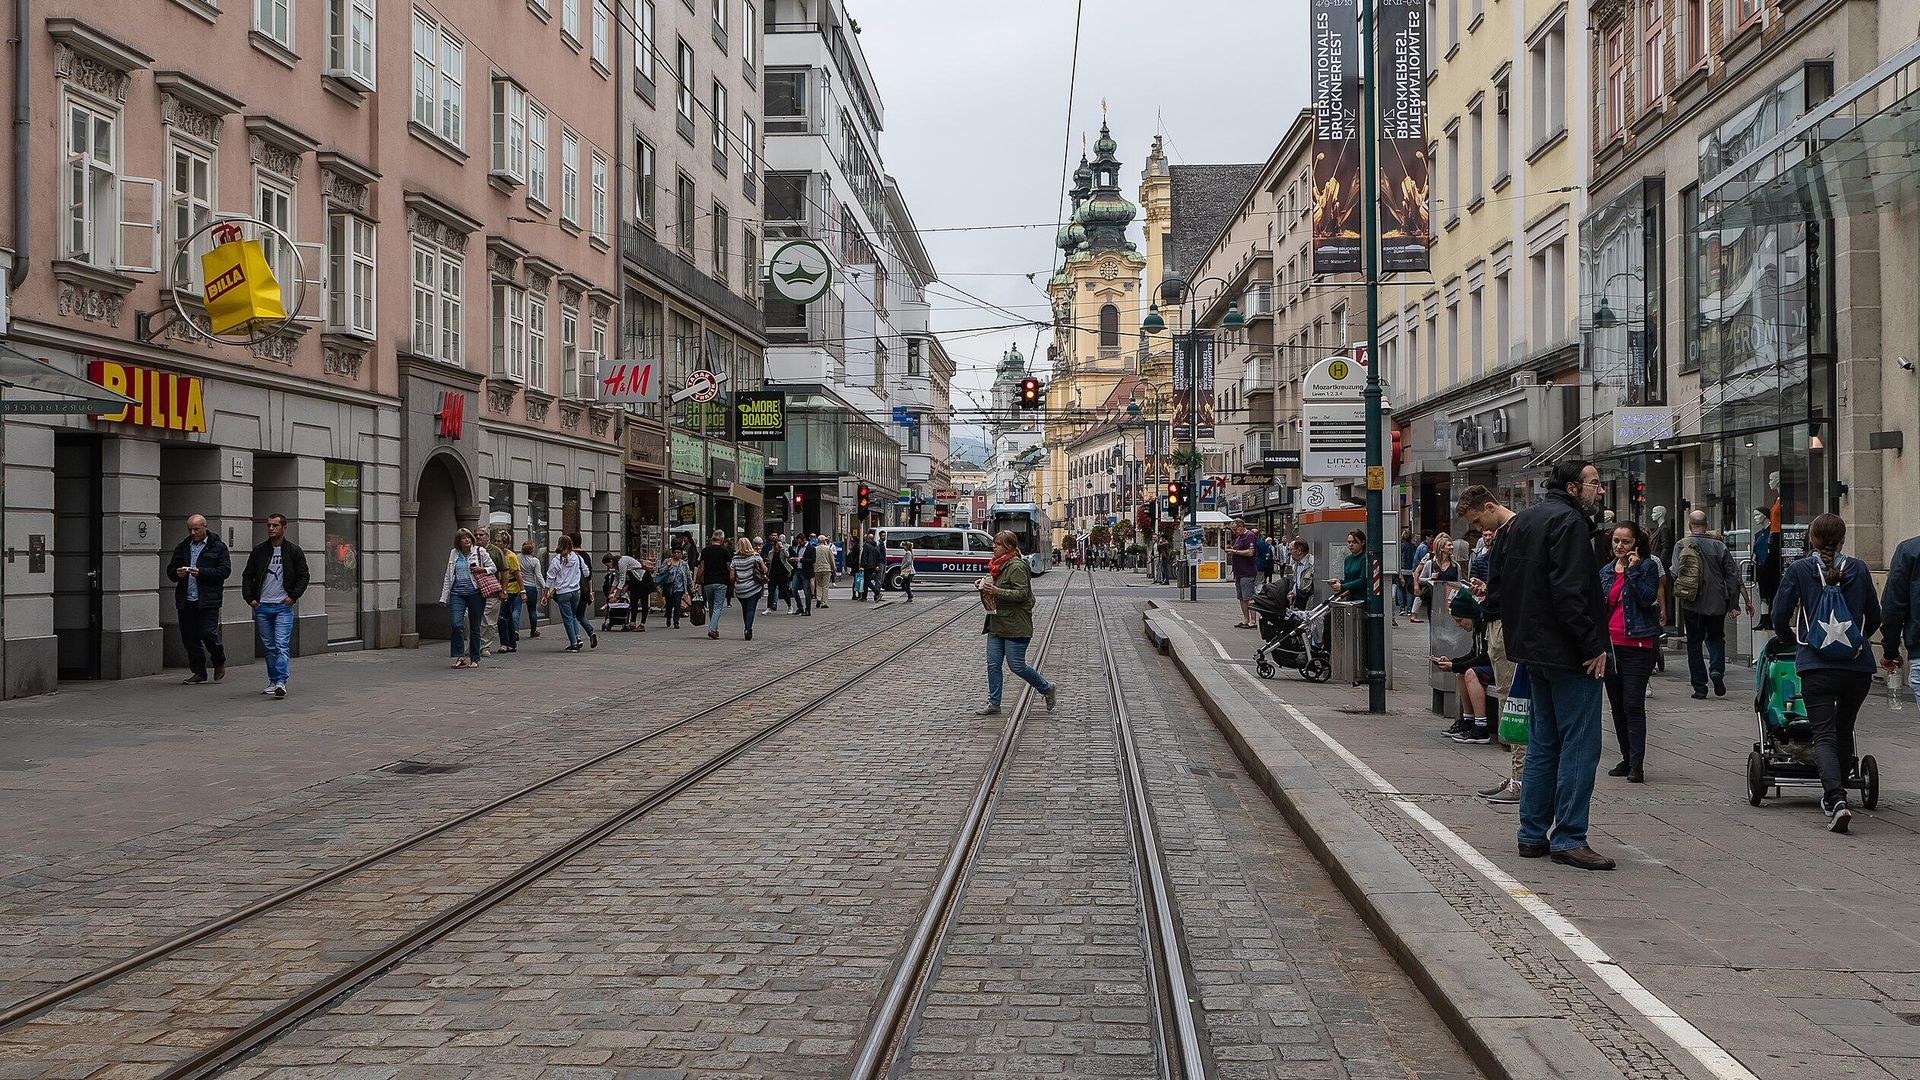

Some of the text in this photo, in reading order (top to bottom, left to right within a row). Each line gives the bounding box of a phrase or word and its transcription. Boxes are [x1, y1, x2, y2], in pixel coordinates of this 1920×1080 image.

[1317, 12, 1329, 141] INTERNATIONALES
[1331, 31, 1342, 140] BRUCKNERFEST
[207, 268, 243, 299] BILLA
[603, 364, 652, 397] H&M
[687, 372, 711, 387] TABAK
[103, 361, 206, 433] BILLA
[751, 400, 778, 413] MORE
[742, 413, 780, 426] BOARDS
[942, 563, 982, 572] POLIZEI
